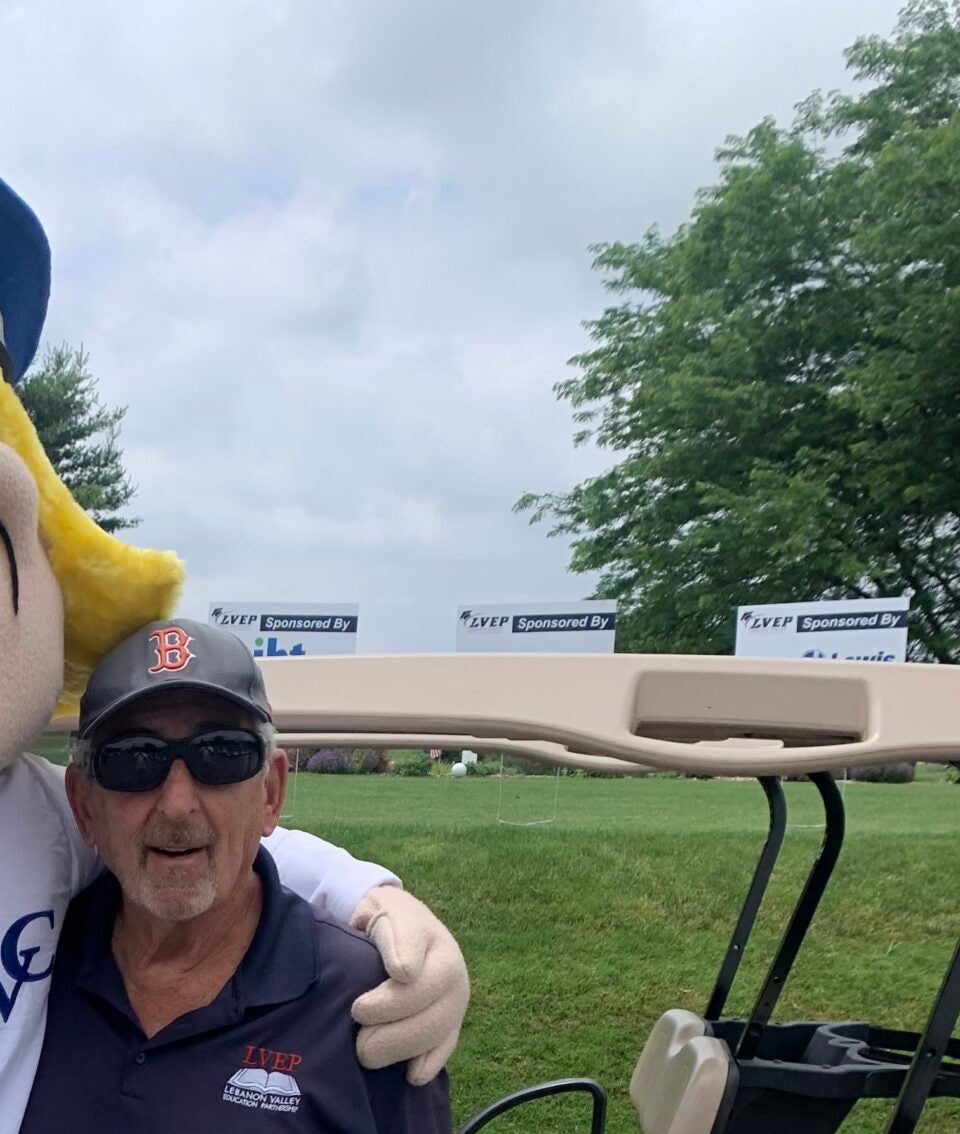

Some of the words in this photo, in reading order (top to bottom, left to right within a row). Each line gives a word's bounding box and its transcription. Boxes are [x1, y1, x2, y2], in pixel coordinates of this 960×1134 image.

[220, 614, 258, 625] LVEP
[265, 617, 330, 631] Sponsored
[333, 618, 350, 631] By
[469, 616, 509, 628] LVEP
[518, 616, 588, 631] Sponsored
[590, 615, 609, 629] By
[751, 616, 793, 629] LVEP
[802, 614, 877, 631] Sponsored
[880, 613, 901, 627] By
[148, 627, 196, 674] B
[242, 1045, 302, 1072] LVEP
[222, 1093, 258, 1108] EDUCATION
[260, 1103, 299, 1113] PARTNERSHIP
[224, 1085, 267, 1102] LEBANON
[269, 1095, 301, 1106] VALLEY
